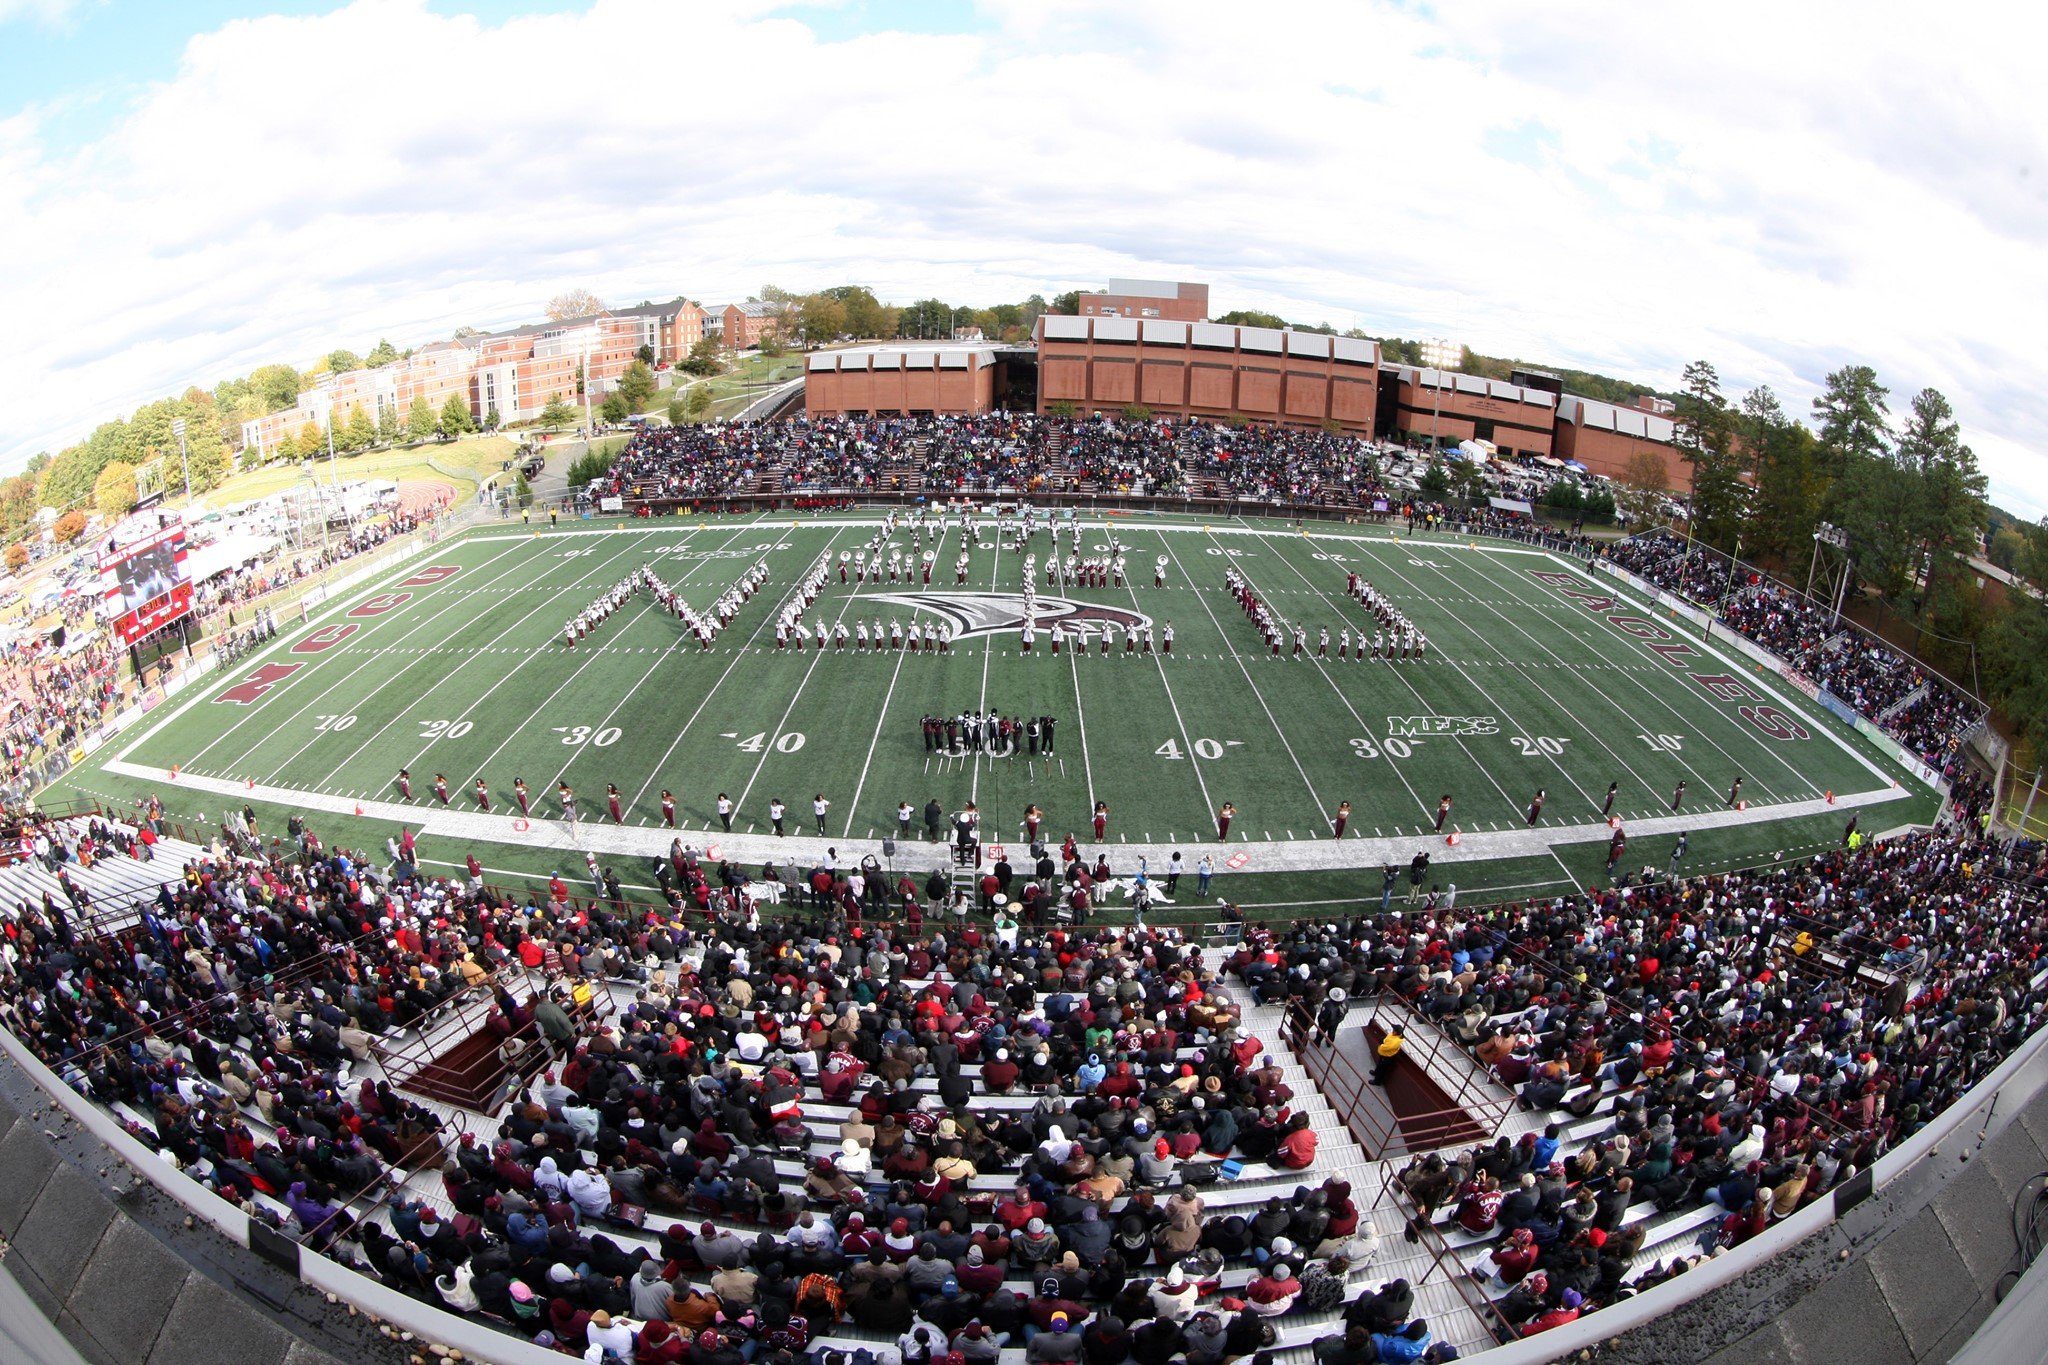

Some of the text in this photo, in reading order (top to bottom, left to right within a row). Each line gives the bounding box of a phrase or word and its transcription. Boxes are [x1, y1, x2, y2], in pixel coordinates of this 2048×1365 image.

[564, 549, 598, 557] 10
[978, 542, 1014, 550] 50
[1206, 548, 1243, 556] 30
[1311, 553, 1347, 561] 20
[1408, 559, 1442, 568] 10
[210, 565, 462, 706] NCCU
[1525, 569, 1811, 741] EAGLES
[314, 715, 358, 731] 10
[418, 720, 474, 739] 20
[1387, 716, 1500, 738] MEAC
[561, 726, 623, 747] 30
[736, 732, 806, 753] 40
[1636, 734, 1682, 751] 10
[1154, 738, 1224, 759] 40
[1349, 738, 1410, 758] 30
[1509, 737, 1564, 755] 20
[989, 847, 1002, 859] 50
